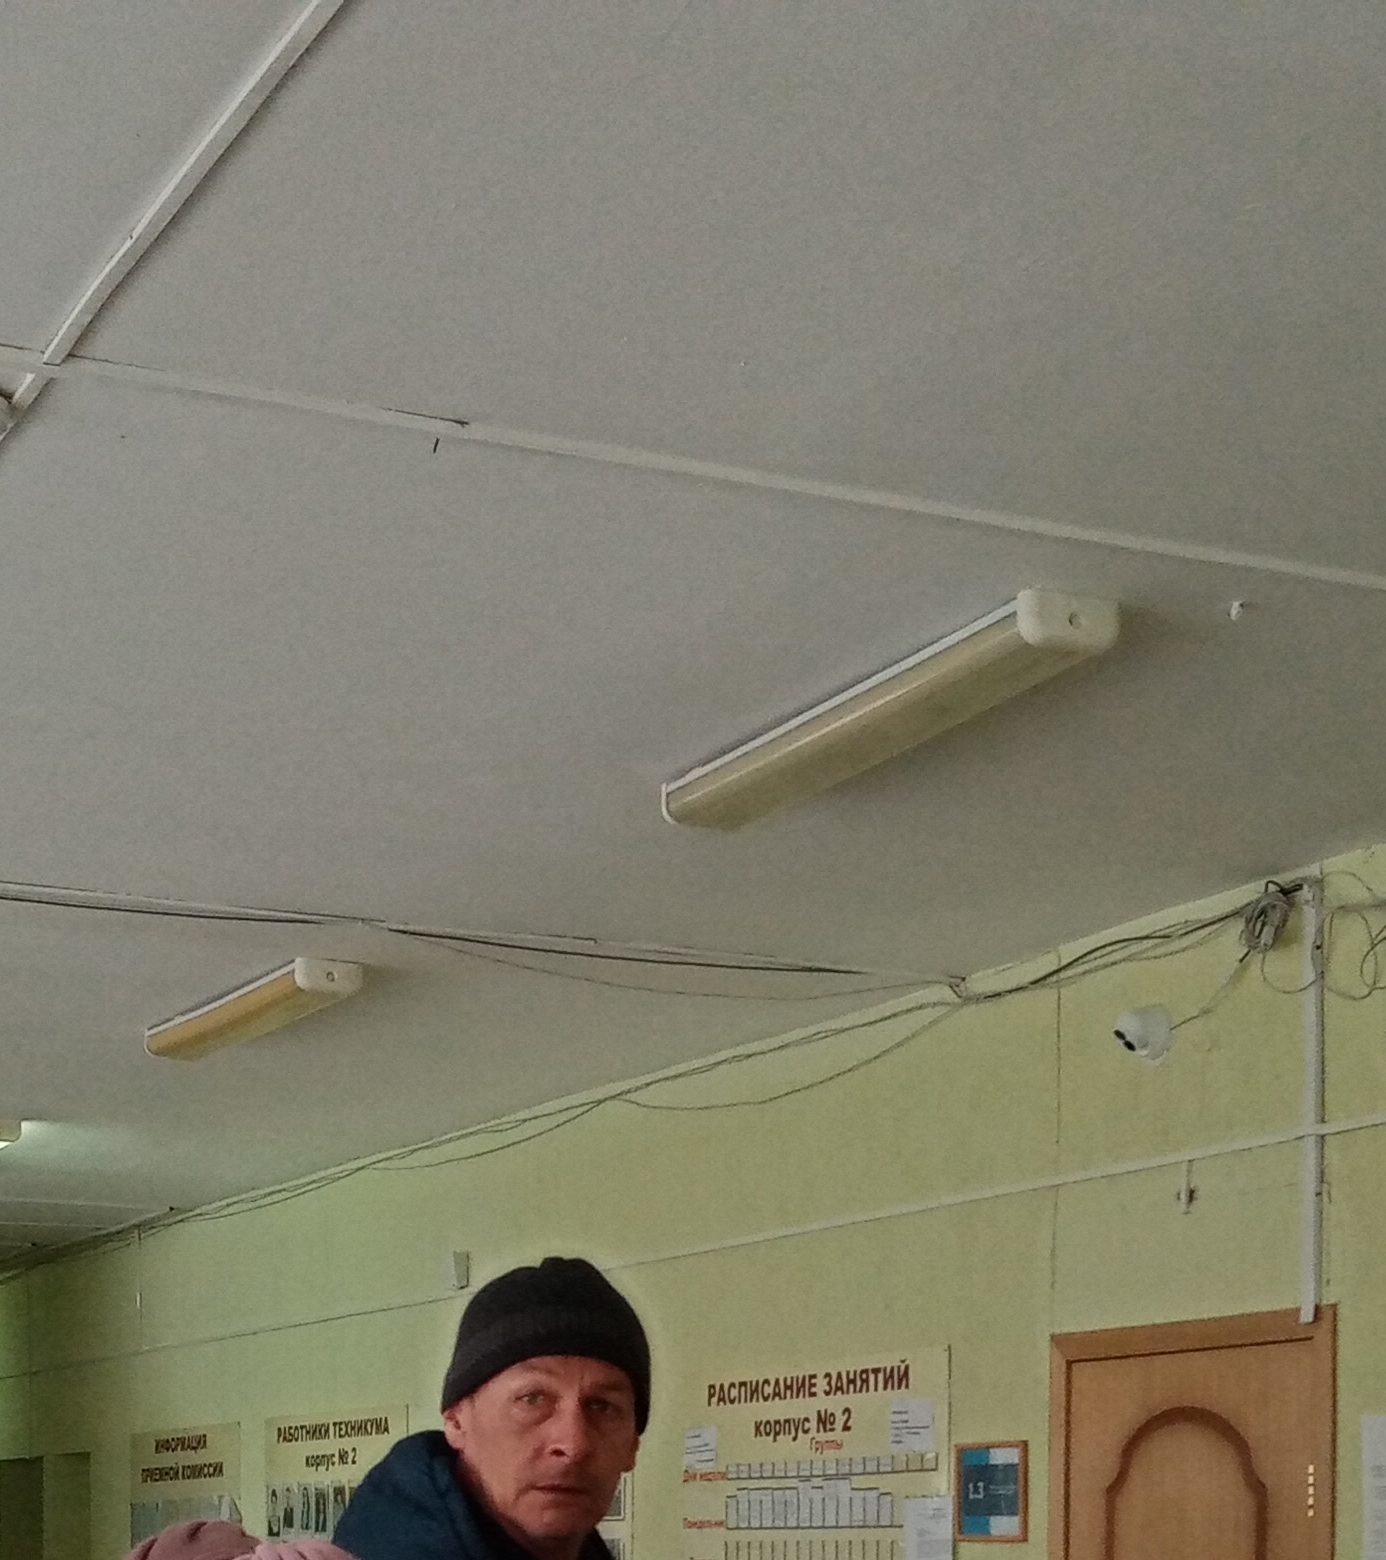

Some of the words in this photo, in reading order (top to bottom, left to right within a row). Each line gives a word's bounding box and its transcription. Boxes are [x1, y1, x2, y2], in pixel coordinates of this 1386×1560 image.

[707, 1374, 818, 1407] РАСПИСАНИЕ
[823, 1358, 910, 1396] ЗАНЯТИЙ
[277, 1420, 330, 1444] РАБОТНИКИ
[331, 1416, 390, 1440] ТЕХНИКУМА
[754, 1415, 811, 1443] корпус
[816, 1408, 837, 1433] №
[842, 1407, 852, 1432] 2
[154, 1433, 207, 1454] ИНФОРМАЦИЯ
[181, 1461, 224, 1481] КОМИССИИ
[305, 1453, 336, 1472] корпус
[337, 1449, 350, 1466] №
[350, 1447, 358, 1465] 2
